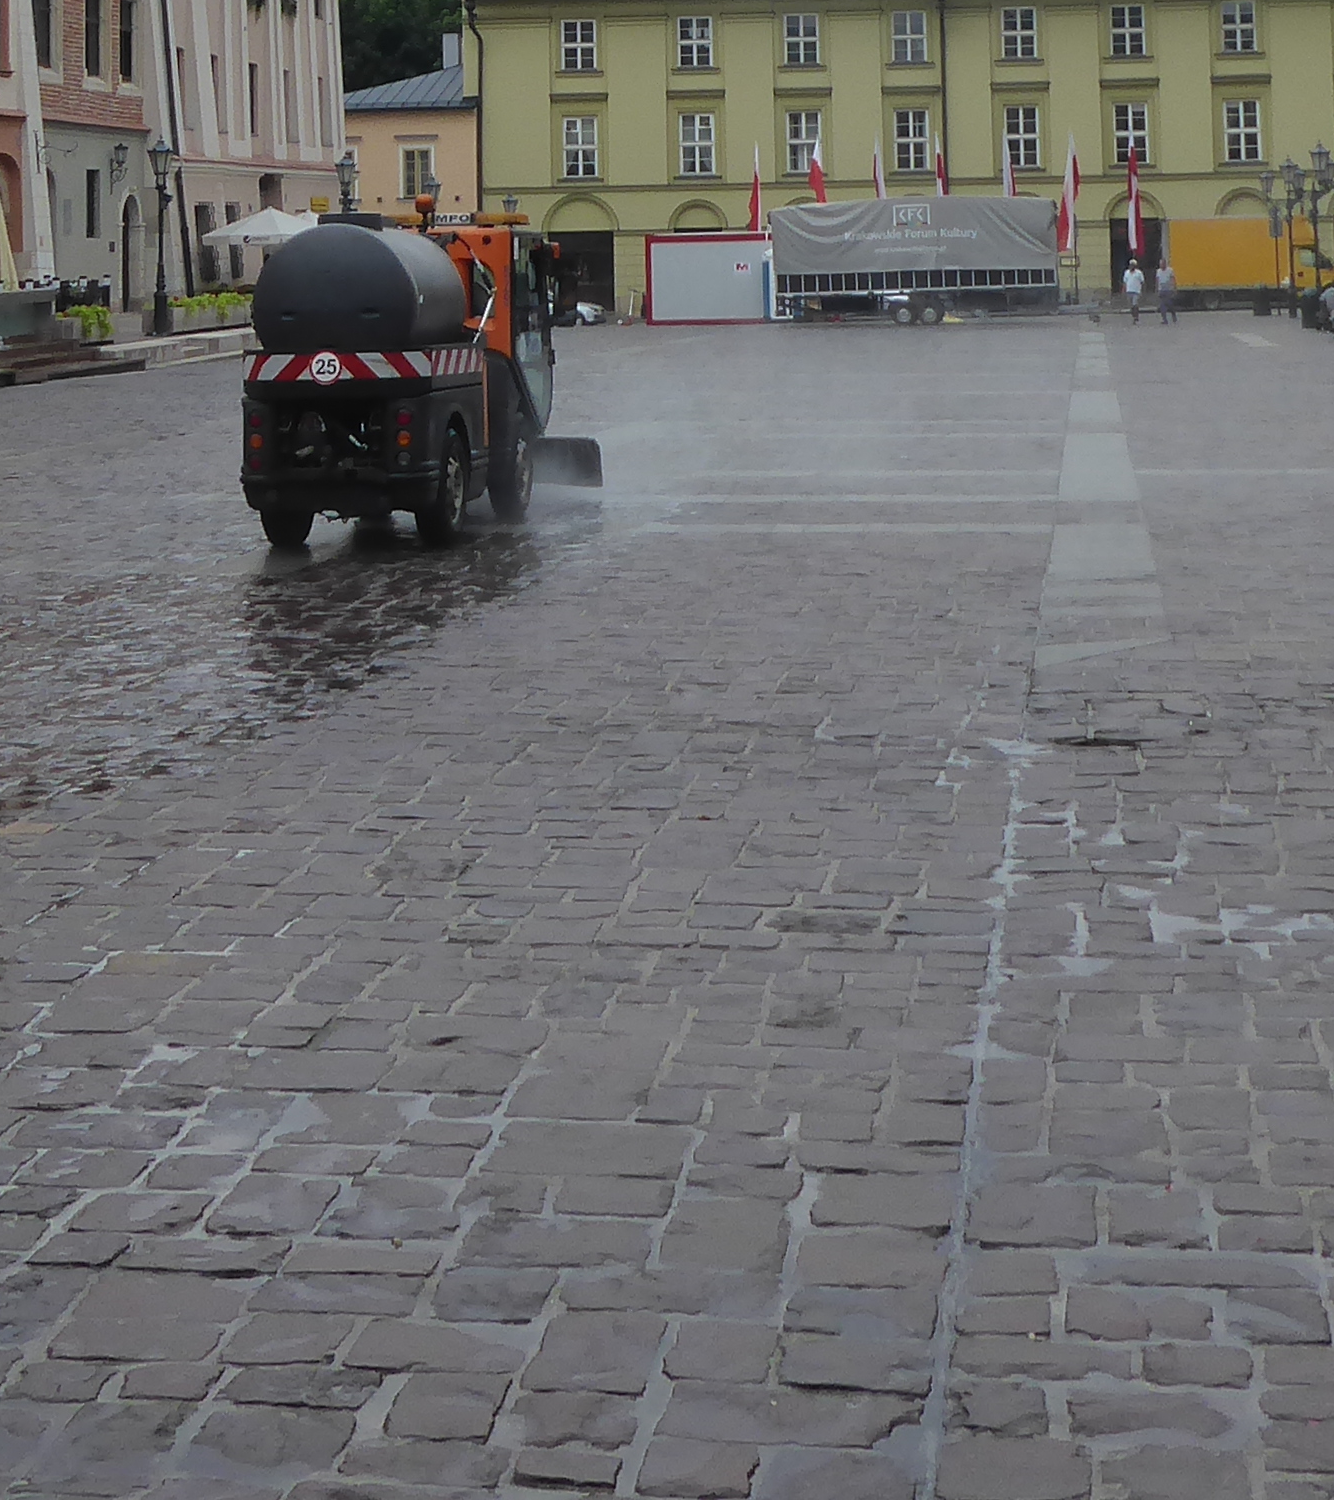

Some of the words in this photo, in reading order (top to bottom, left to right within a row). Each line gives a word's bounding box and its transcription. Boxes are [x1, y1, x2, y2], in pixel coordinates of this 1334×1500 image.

[905, 228, 938, 239] Forum
[940, 227, 978, 239] Kultury
[315, 358, 337, 375] 25
